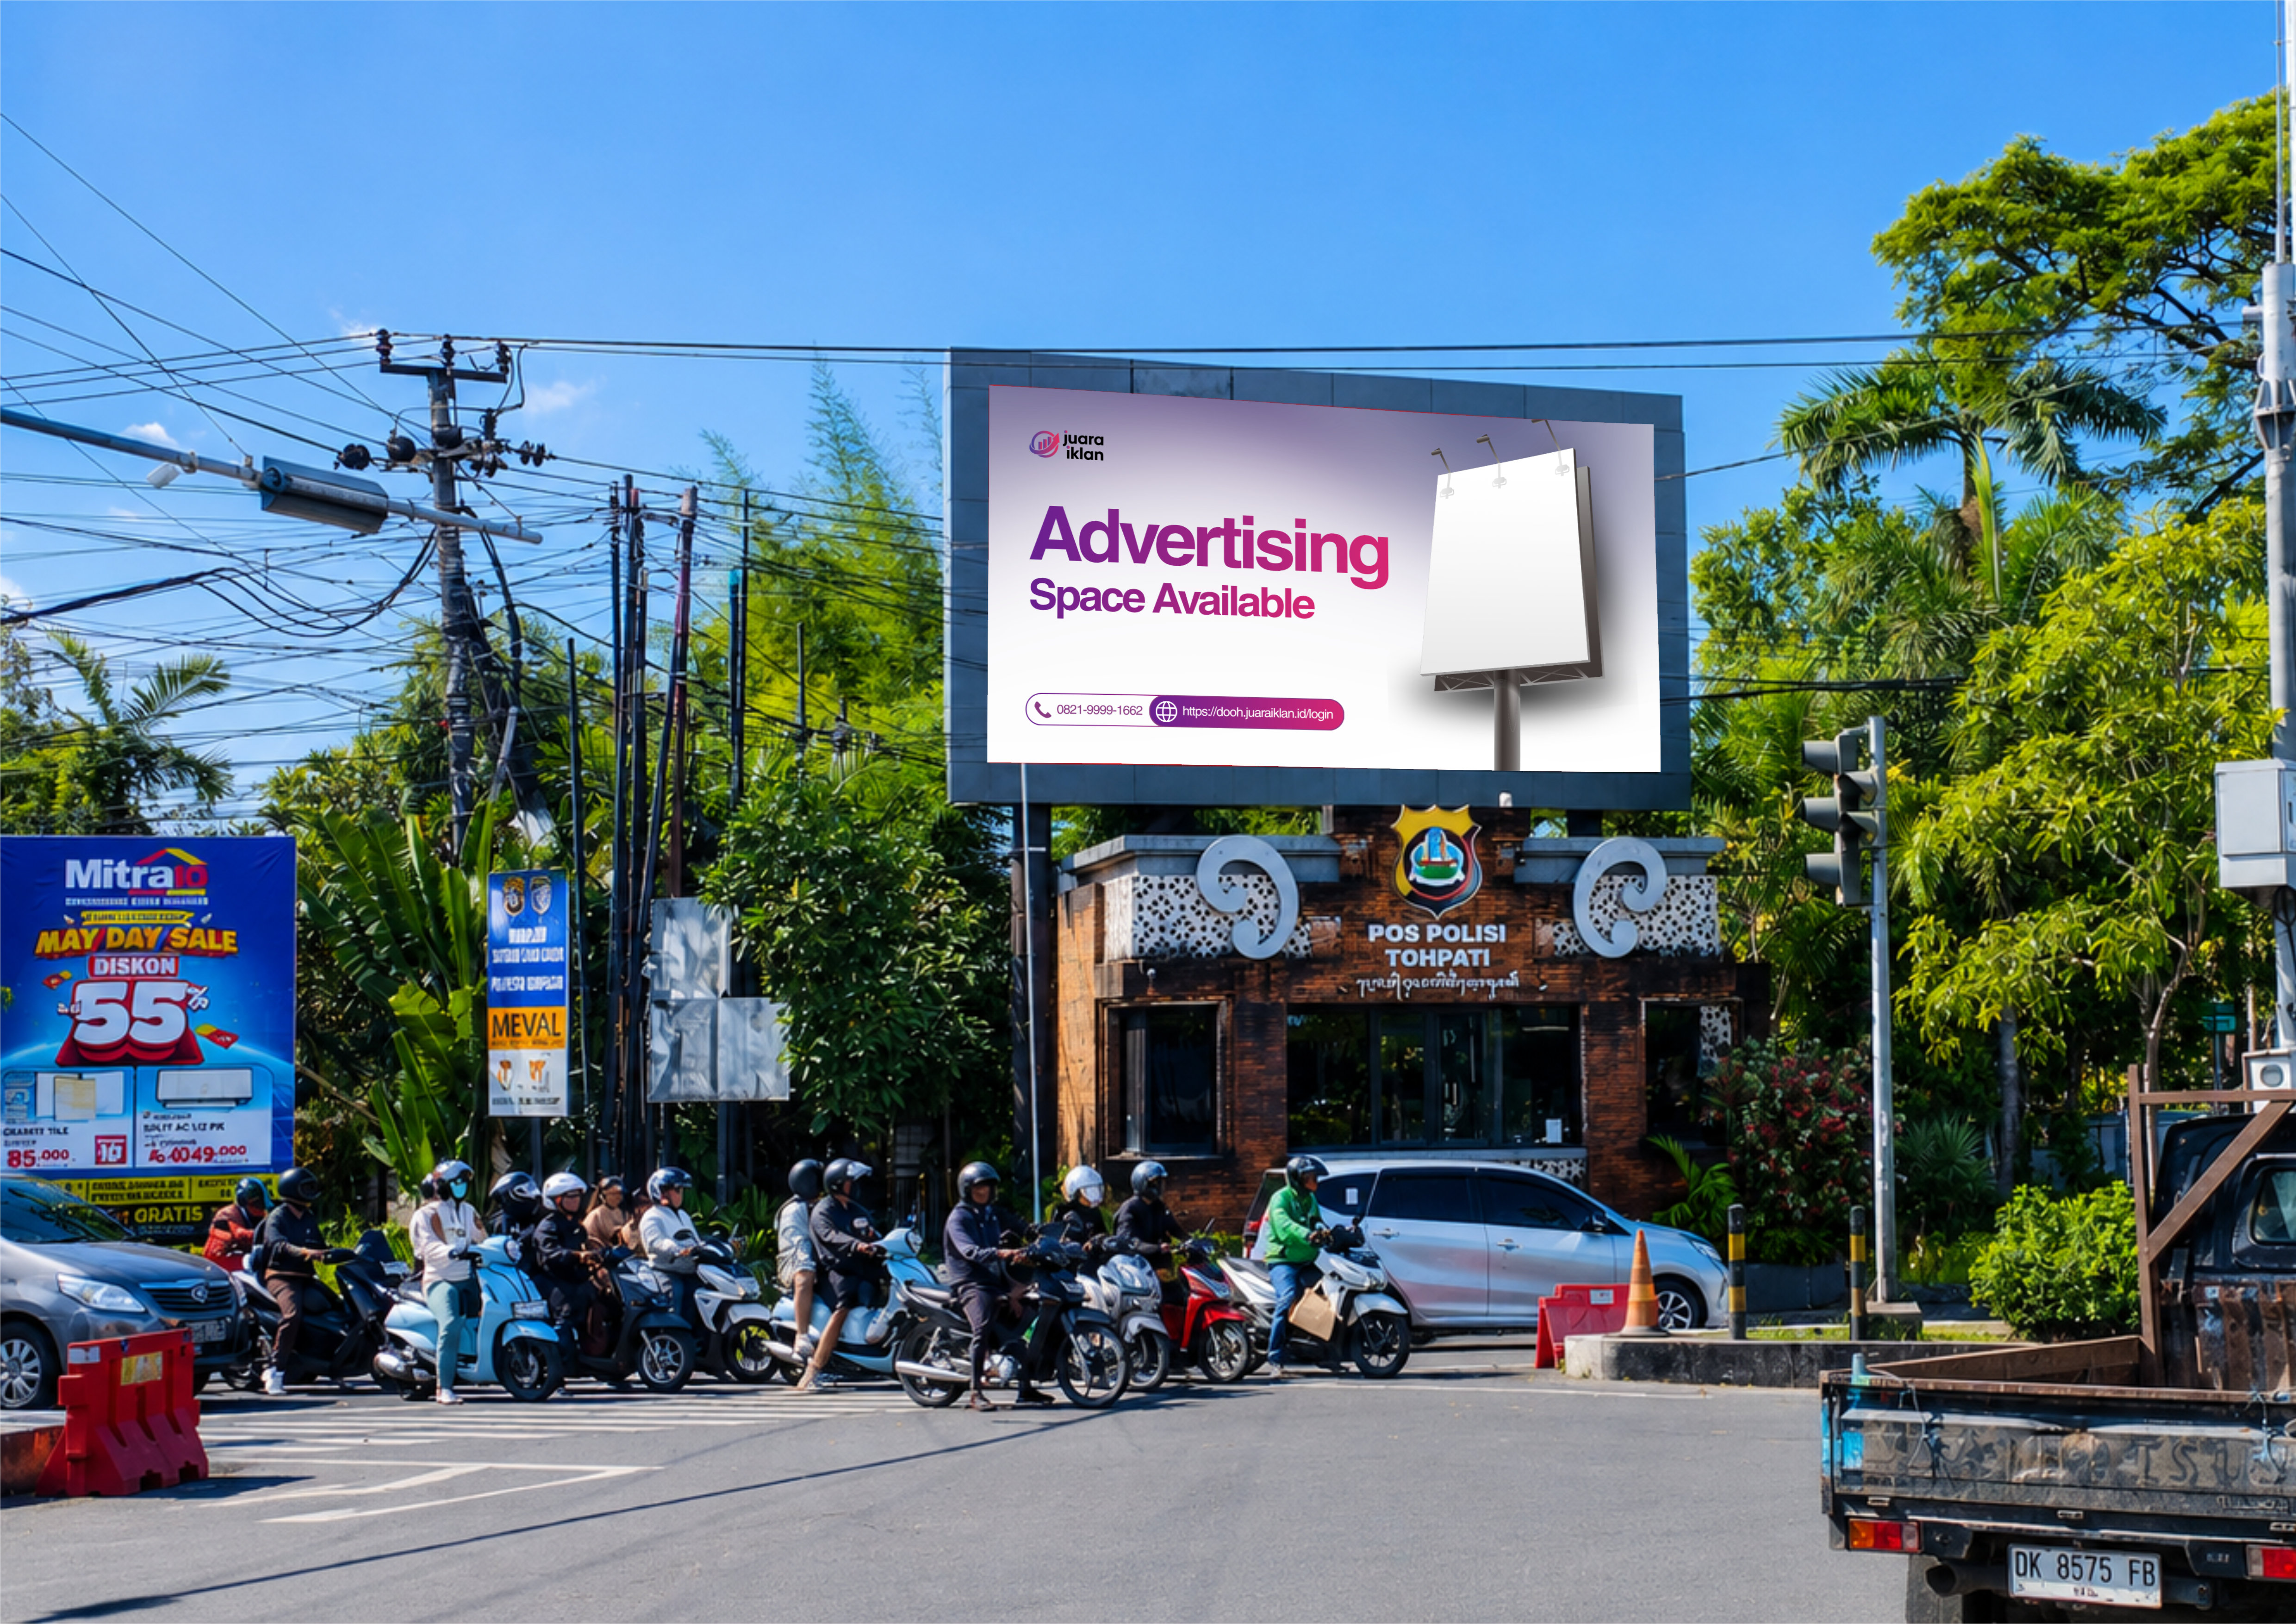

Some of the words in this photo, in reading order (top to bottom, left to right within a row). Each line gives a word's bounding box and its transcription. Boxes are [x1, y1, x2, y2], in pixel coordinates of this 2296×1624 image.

[1063, 430, 1104, 446] juara
[1066, 445, 1104, 461] iklan
[1029, 506, 1389, 590] Advertising
[1029, 577, 1145, 619] Space
[1152, 582, 1315, 619] Available
[1057, 704, 1143, 715] 0821-9999-1662
[1183, 706, 1334, 721] https://dooh.juaraiklan.id/login
[65, 859, 208, 888] Mitra10
[35, 928, 99, 954] MAY
[106, 926, 162, 949] DAY
[170, 927, 238, 953] SALE
[1368, 924, 1420, 943] POS
[1426, 924, 1506, 943] POLISI
[94, 957, 175, 975] DISKON
[1385, 949, 1490, 967] TOHPATI
[493, 1012, 561, 1037] MEVAL
[134, 1206, 203, 1223] GRATIS
[2015, 1551, 2041, 1578] DK
[2057, 1553, 2112, 1583] 8575
[2128, 1559, 2155, 1587] FB
